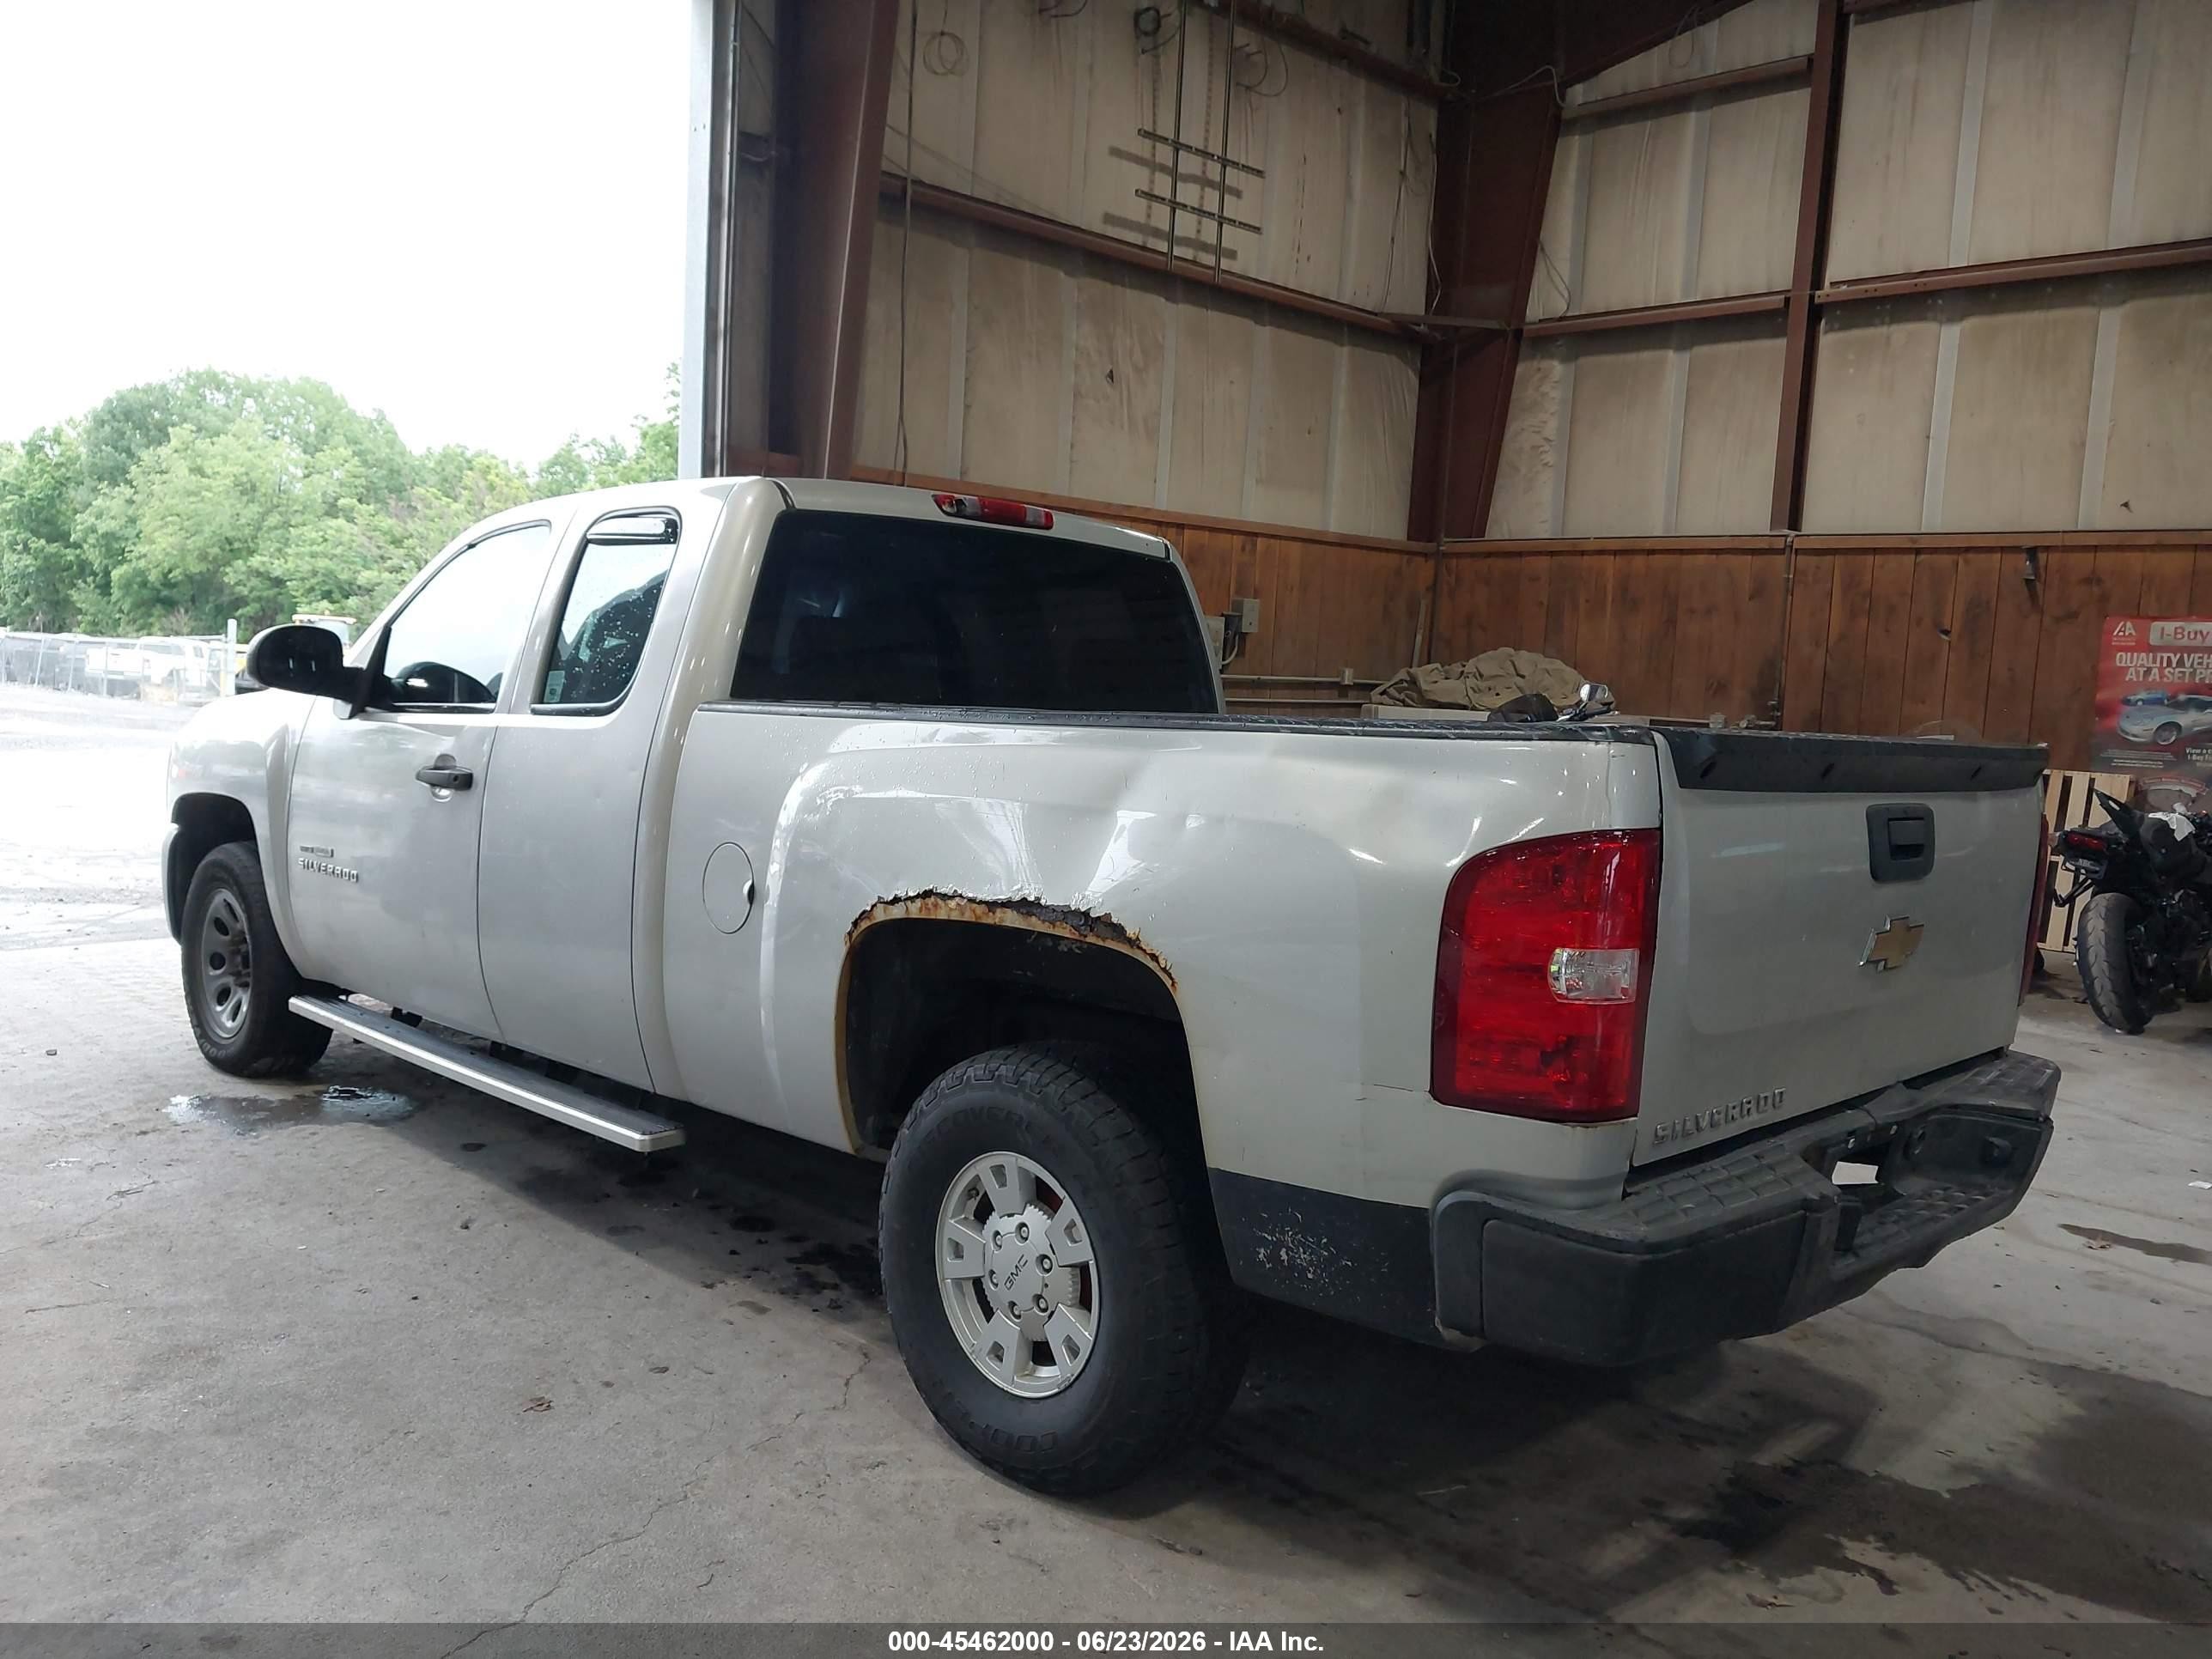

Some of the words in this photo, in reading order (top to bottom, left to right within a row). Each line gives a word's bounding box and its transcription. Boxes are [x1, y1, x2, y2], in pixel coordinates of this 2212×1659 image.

[2160, 626, 2210, 644] I-Buy
[2116, 652, 2181, 668] QUALITY
[2125, 666, 2147, 681] AT
[2148, 667, 2160, 682] A
[2164, 667, 2193, 683] SET
[298, 857, 359, 883] SILVERADO
[1653, 1087, 1786, 1146] SILVERADO
[1004, 1254, 1028, 1291] GMC
